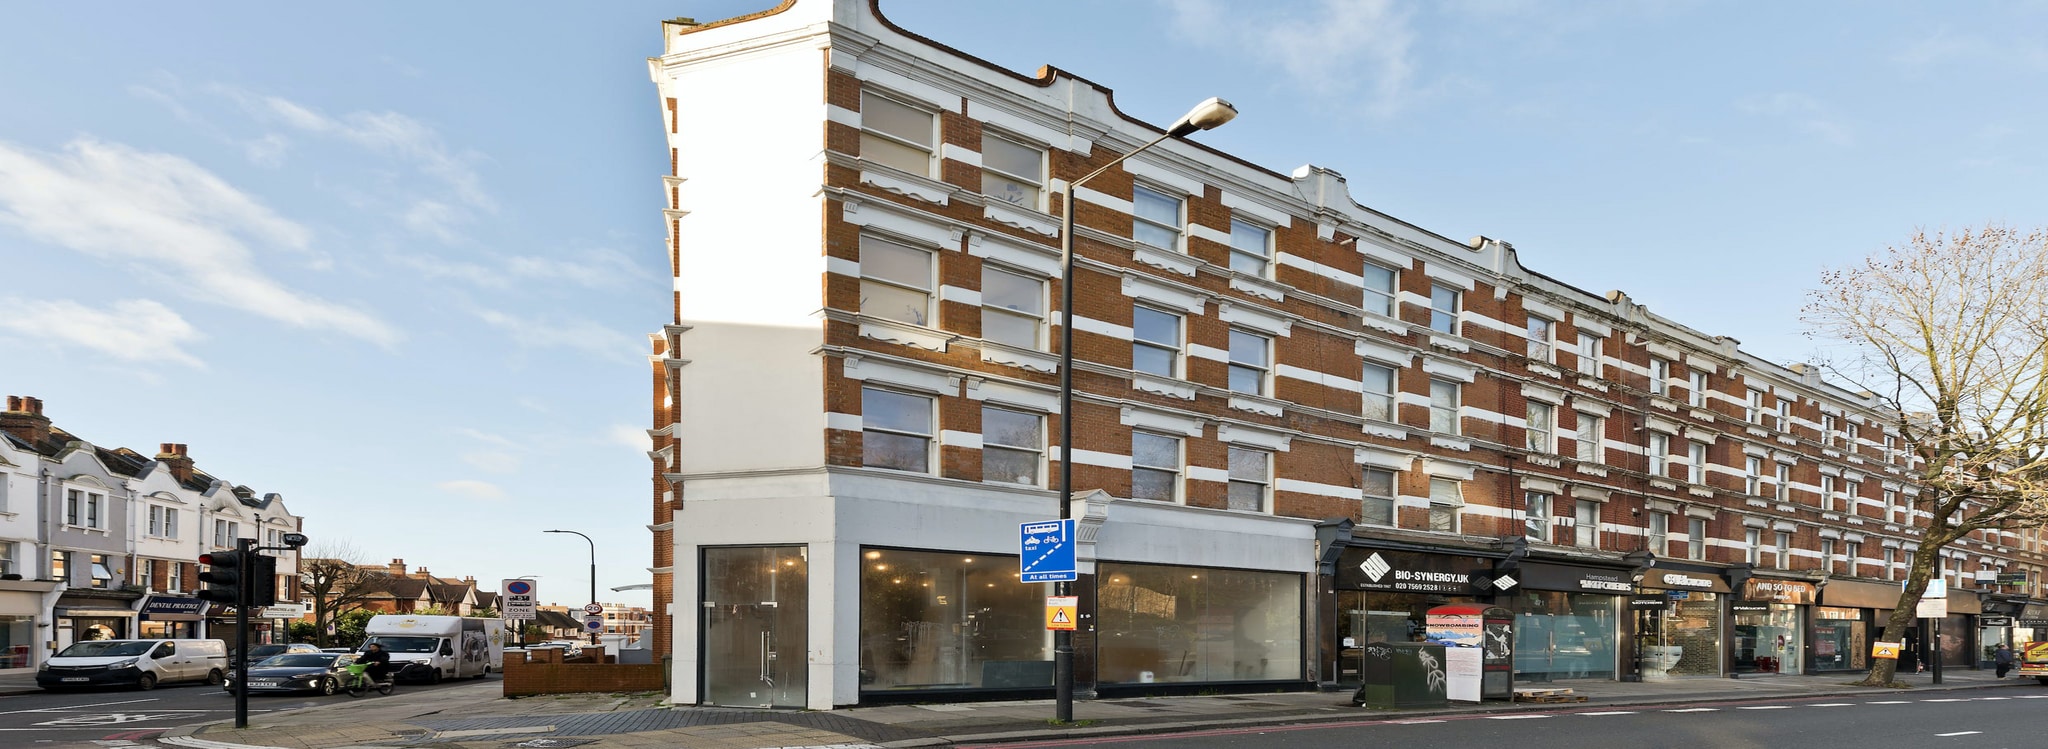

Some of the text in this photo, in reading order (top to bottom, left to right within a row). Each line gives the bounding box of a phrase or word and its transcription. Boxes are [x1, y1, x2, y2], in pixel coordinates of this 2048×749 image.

[1395, 570, 1469, 583] BIO-SYNERGY.UK
[1586, 573, 1619, 582] Hampstead
[1757, 582, 1772, 591] AND
[1773, 583, 1782, 591] SO
[1784, 584, 1792, 592] TO
